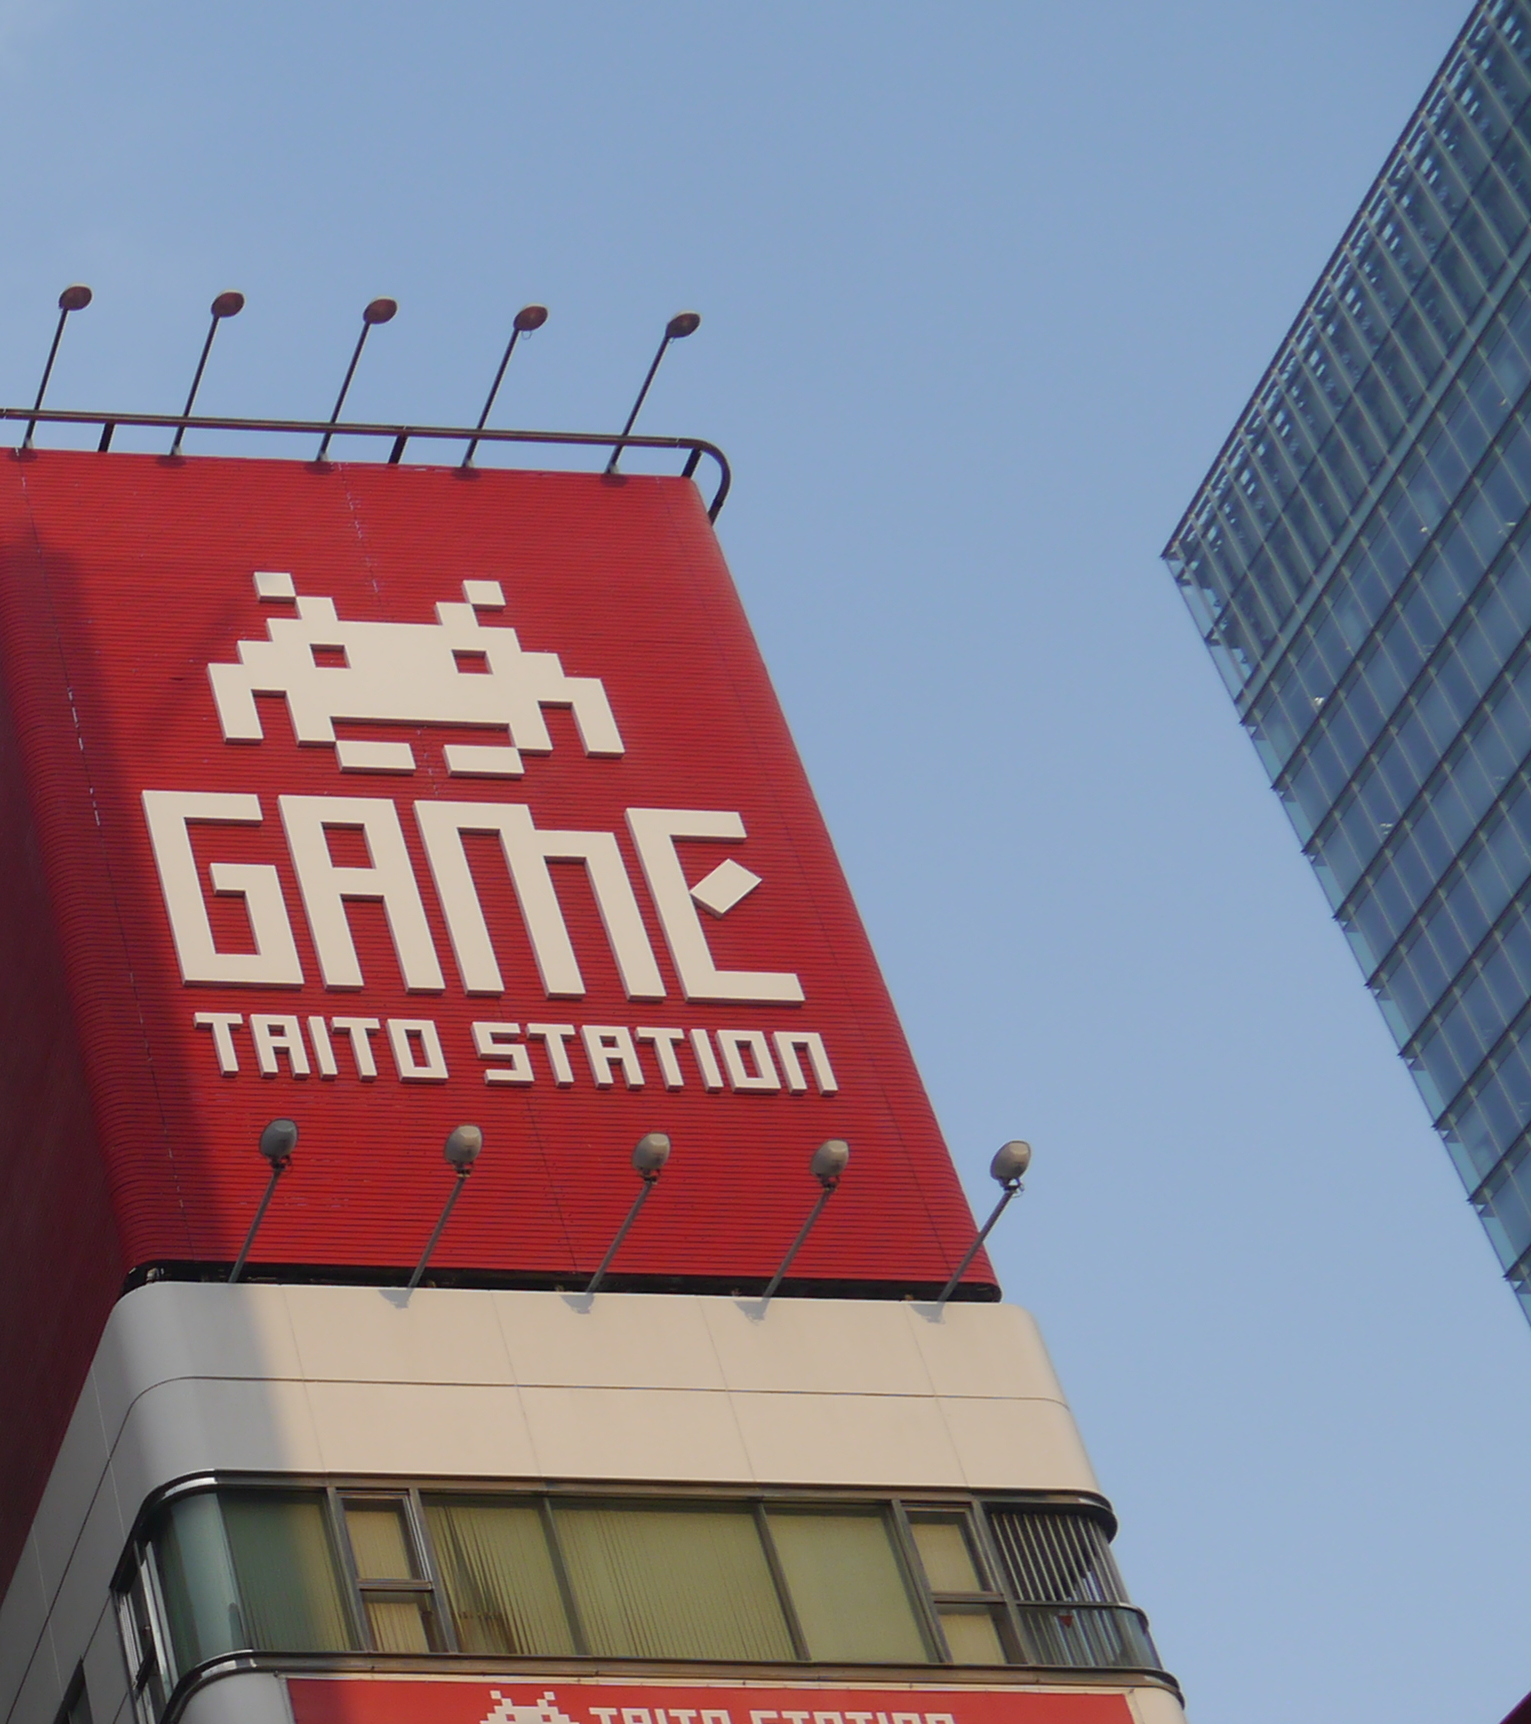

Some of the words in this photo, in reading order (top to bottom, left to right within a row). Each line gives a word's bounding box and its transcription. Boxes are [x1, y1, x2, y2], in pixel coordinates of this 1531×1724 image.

[141, 789, 806, 1006] GAME
[194, 1011, 449, 1084] TAITO
[470, 1020, 840, 1095] STATION
